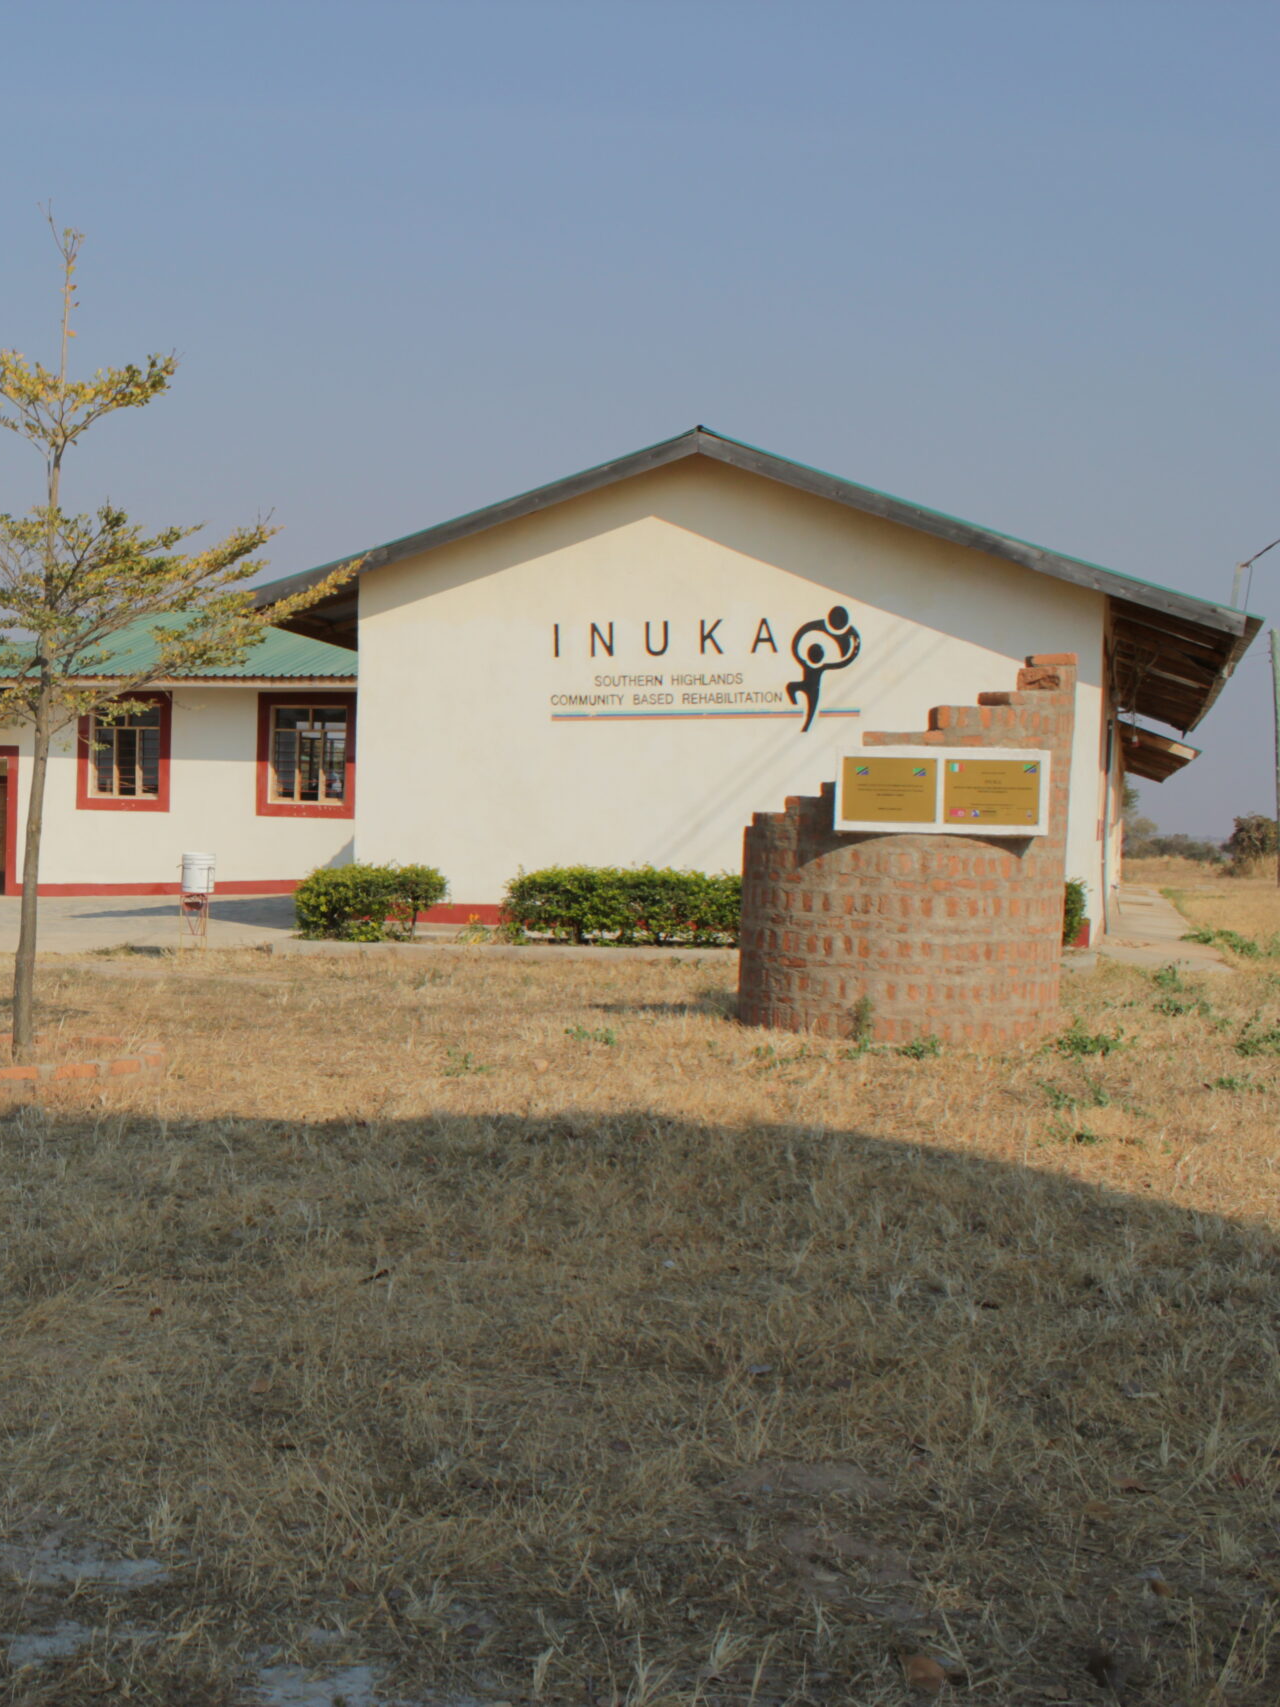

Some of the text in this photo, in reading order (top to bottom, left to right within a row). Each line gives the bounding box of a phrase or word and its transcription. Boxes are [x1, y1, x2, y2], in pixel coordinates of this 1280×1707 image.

[553, 618, 778, 657] INUKA
[594, 672, 744, 687] SOUTHERN HIGHLANDS
[551, 691, 783, 706] COMMUNITY BASED REHABILITATION
